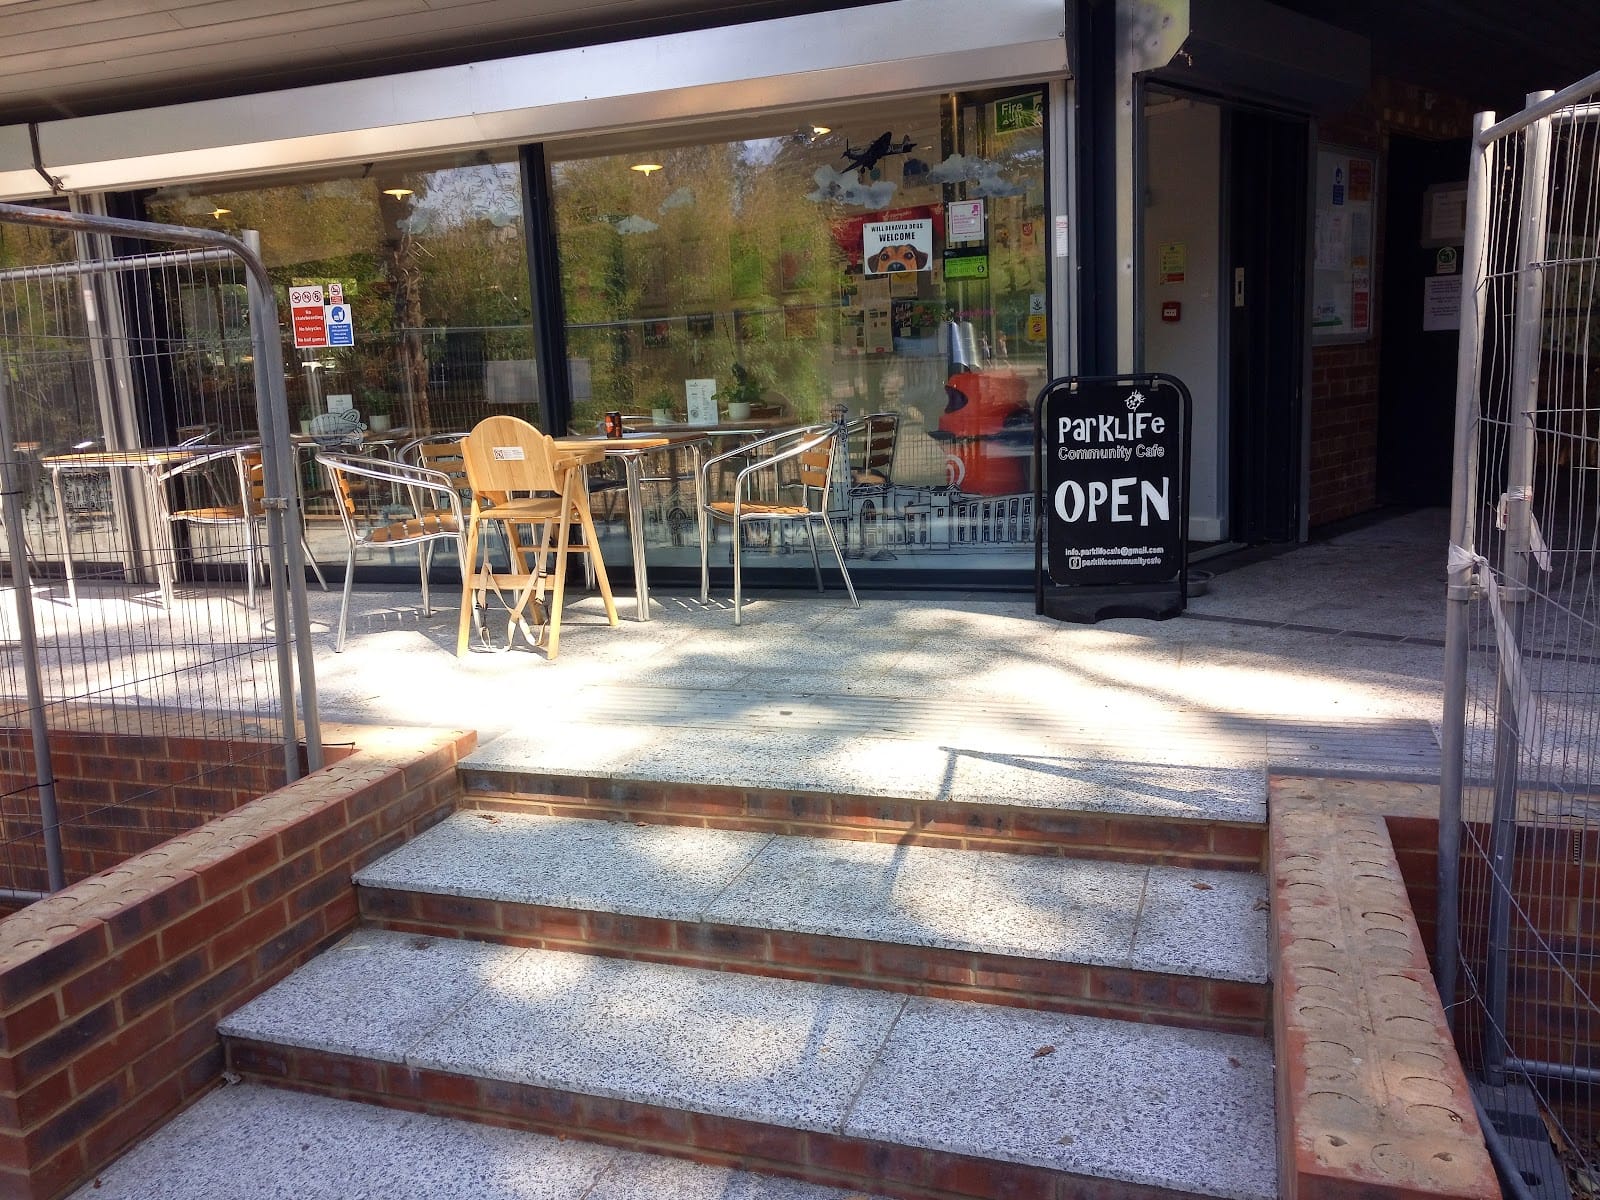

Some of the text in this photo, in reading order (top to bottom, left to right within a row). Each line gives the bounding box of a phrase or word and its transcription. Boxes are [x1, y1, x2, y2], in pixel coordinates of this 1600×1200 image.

[1002, 103, 1023, 115] Fire
[879, 232, 916, 242] WELCOME
[1058, 443, 1165, 462] Community Cafe
[1054, 476, 1170, 527] OPEN
